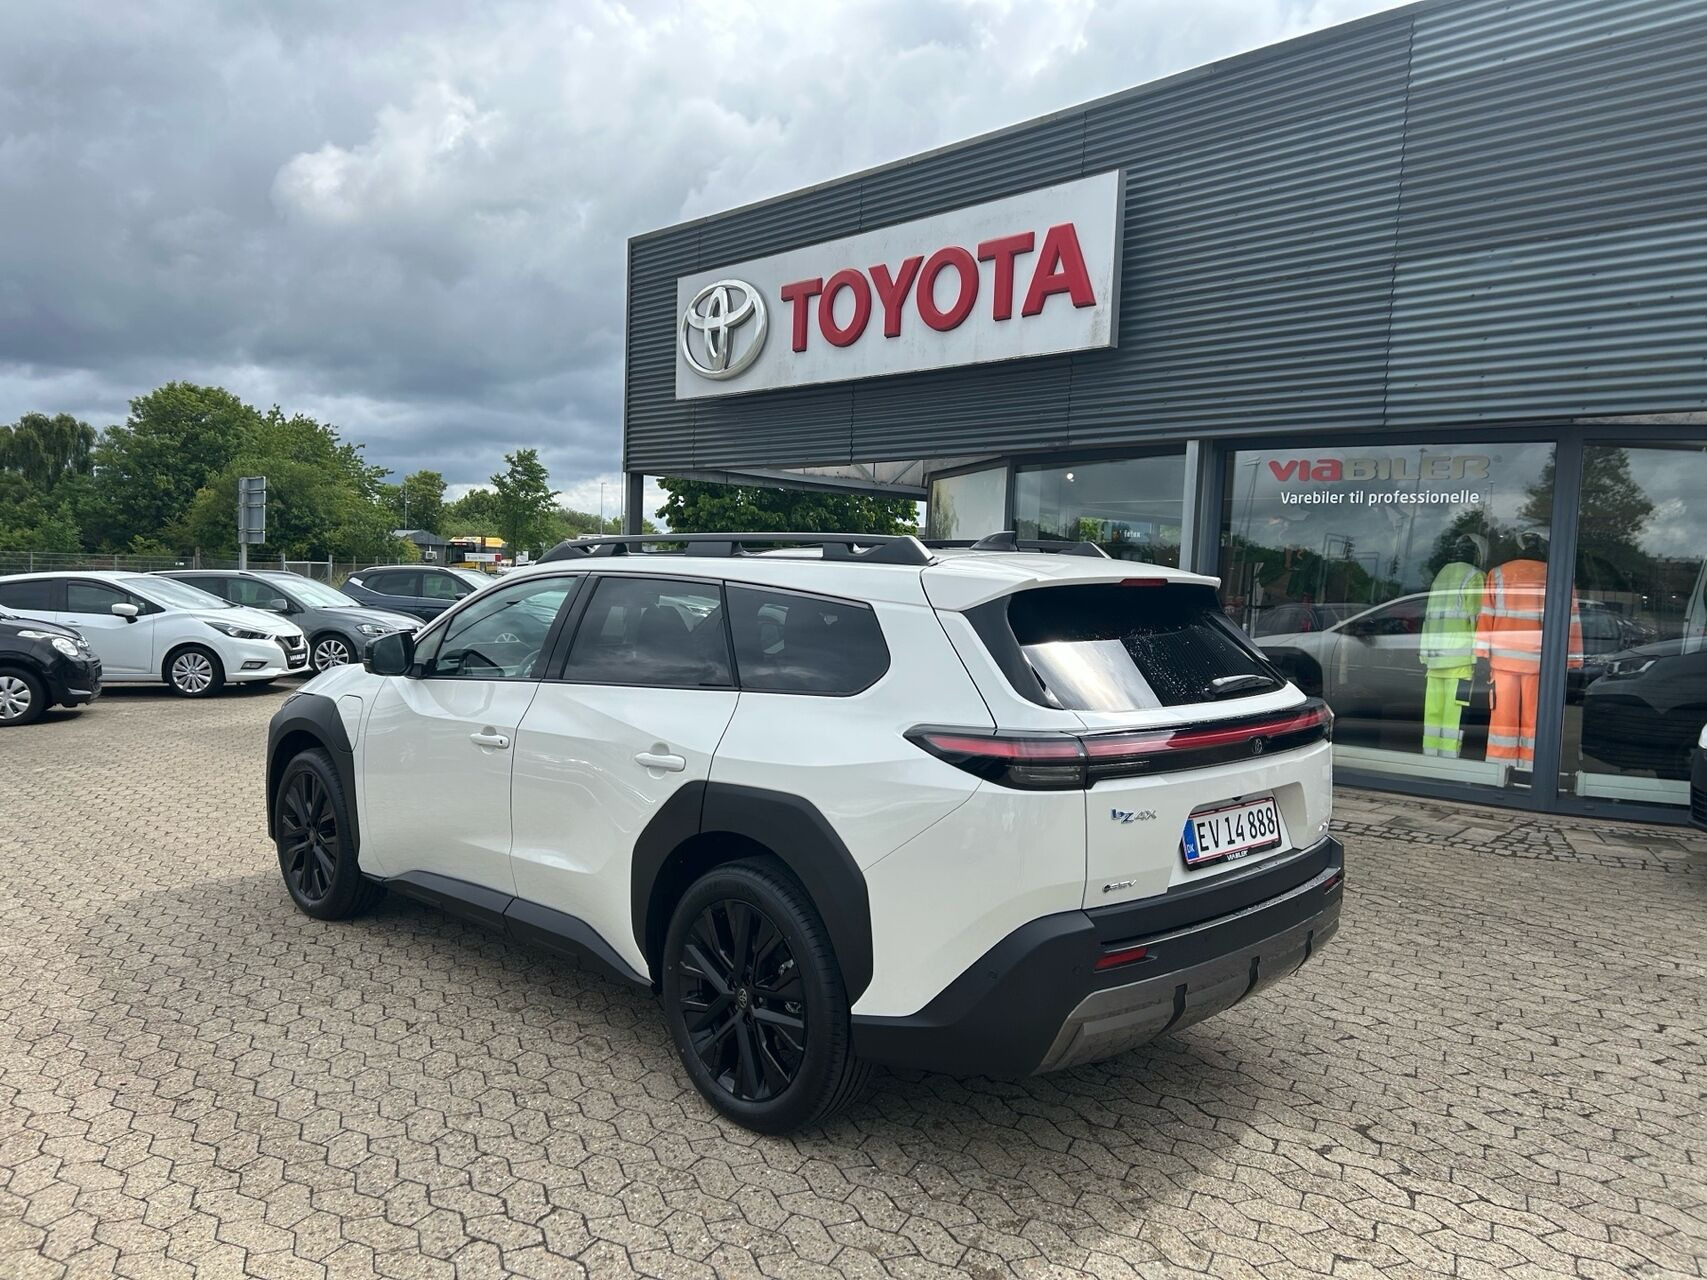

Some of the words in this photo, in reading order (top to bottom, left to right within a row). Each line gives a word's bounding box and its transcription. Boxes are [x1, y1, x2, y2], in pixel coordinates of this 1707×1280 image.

[781, 222, 1097, 353] TOYOTA
[1280, 490, 1345, 504] Varebiler
[1349, 489, 1363, 504] til
[1368, 489, 1480, 507] professionelle
[1196, 818, 1220, 852] EV
[1225, 813, 1246, 846] 14
[1247, 806, 1276, 840] 888
